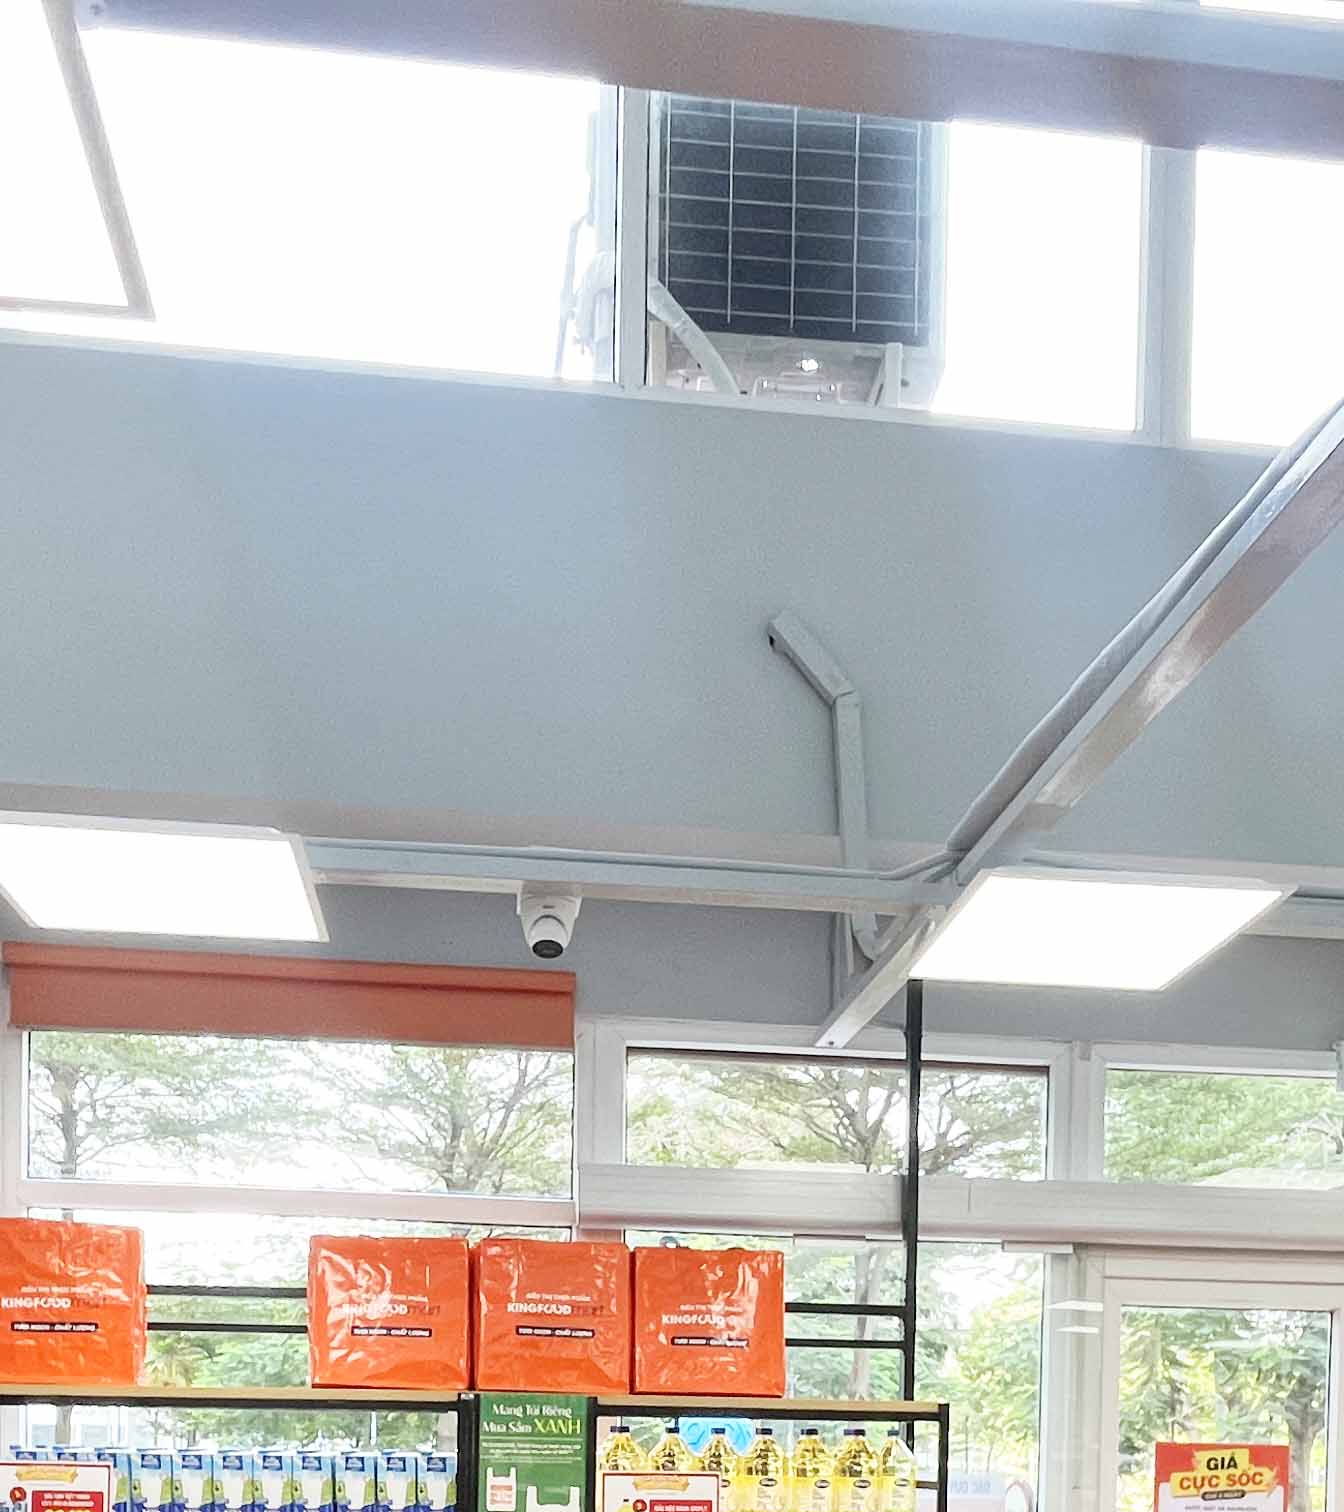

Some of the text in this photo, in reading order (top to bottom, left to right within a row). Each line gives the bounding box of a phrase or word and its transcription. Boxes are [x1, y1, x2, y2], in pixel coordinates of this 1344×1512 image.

[0, 1296, 72, 1310] KINGFOOD
[507, 1302, 572, 1315] KINGFOOD
[493, 1404, 523, 1417] Mang
[482, 1419, 582, 1434] Mua Sắm XANH
[1206, 1453, 1238, 1471] GIÁ
[1179, 1469, 1264, 1491] CỰC SỐC
